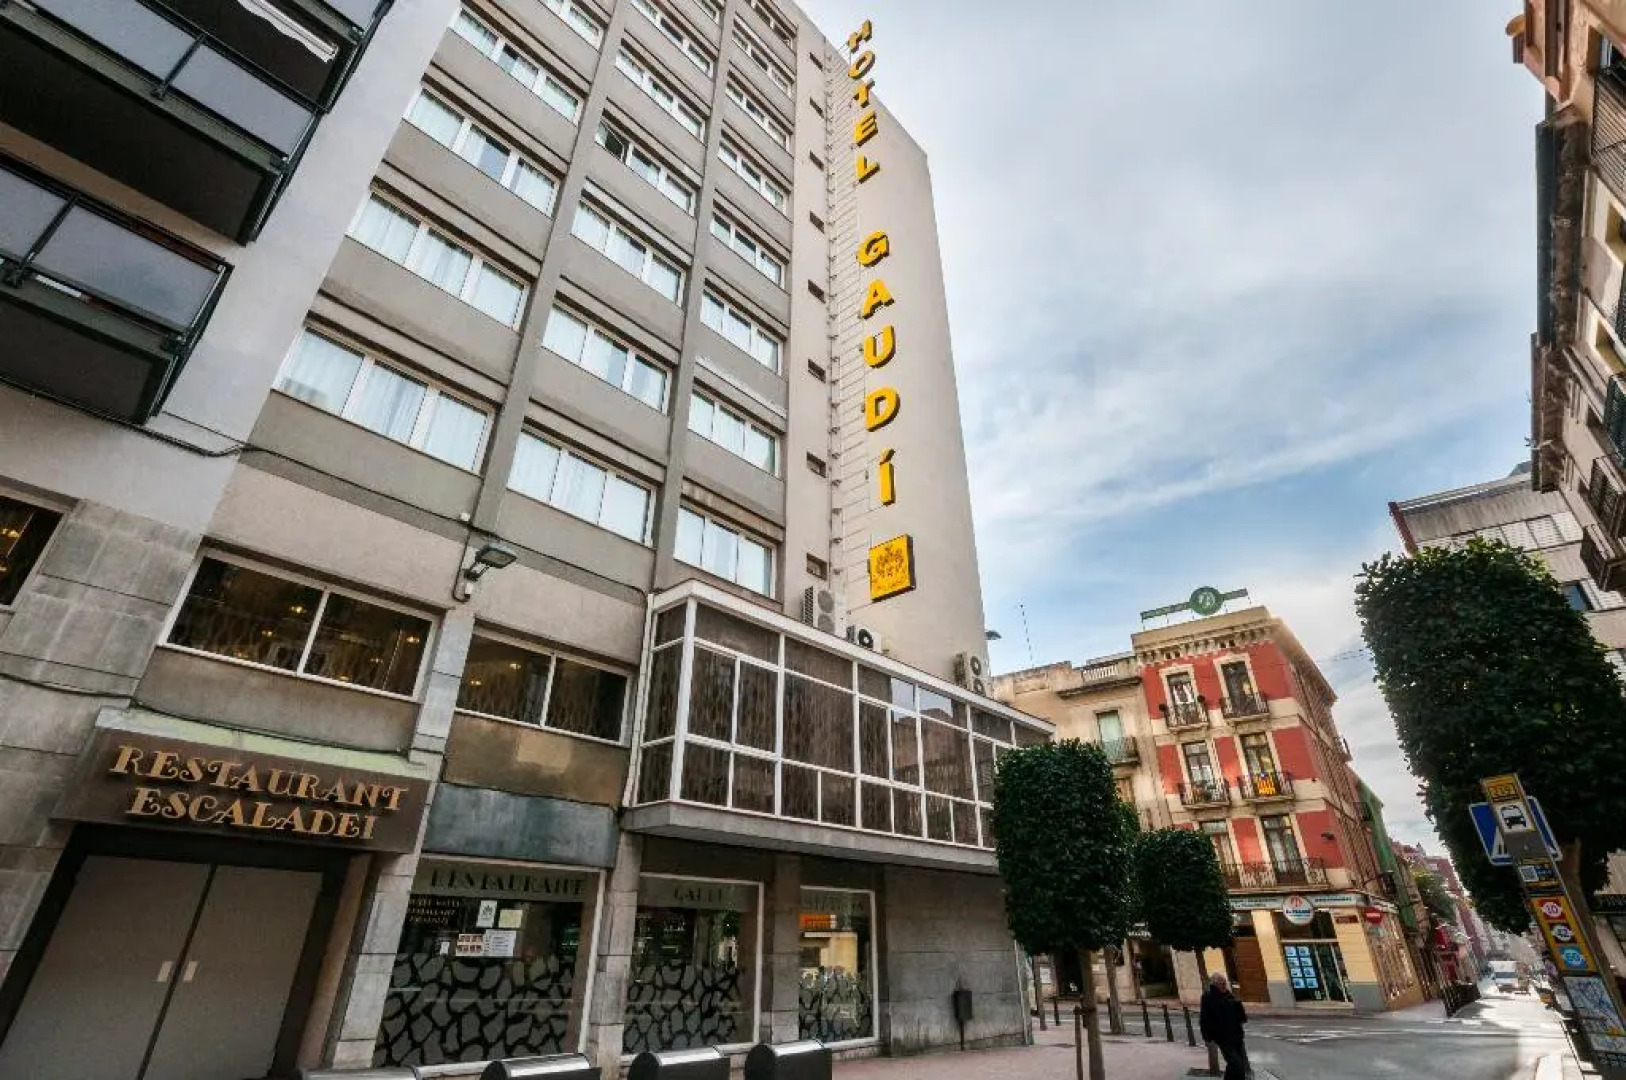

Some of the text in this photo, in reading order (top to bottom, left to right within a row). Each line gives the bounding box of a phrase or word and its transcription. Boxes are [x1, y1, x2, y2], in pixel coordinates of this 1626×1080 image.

[848, 19, 900, 506] HOTEL GAUDÍ
[109, 744, 408, 811] RESTAURANT
[125, 786, 379, 840] ESCALADEI
